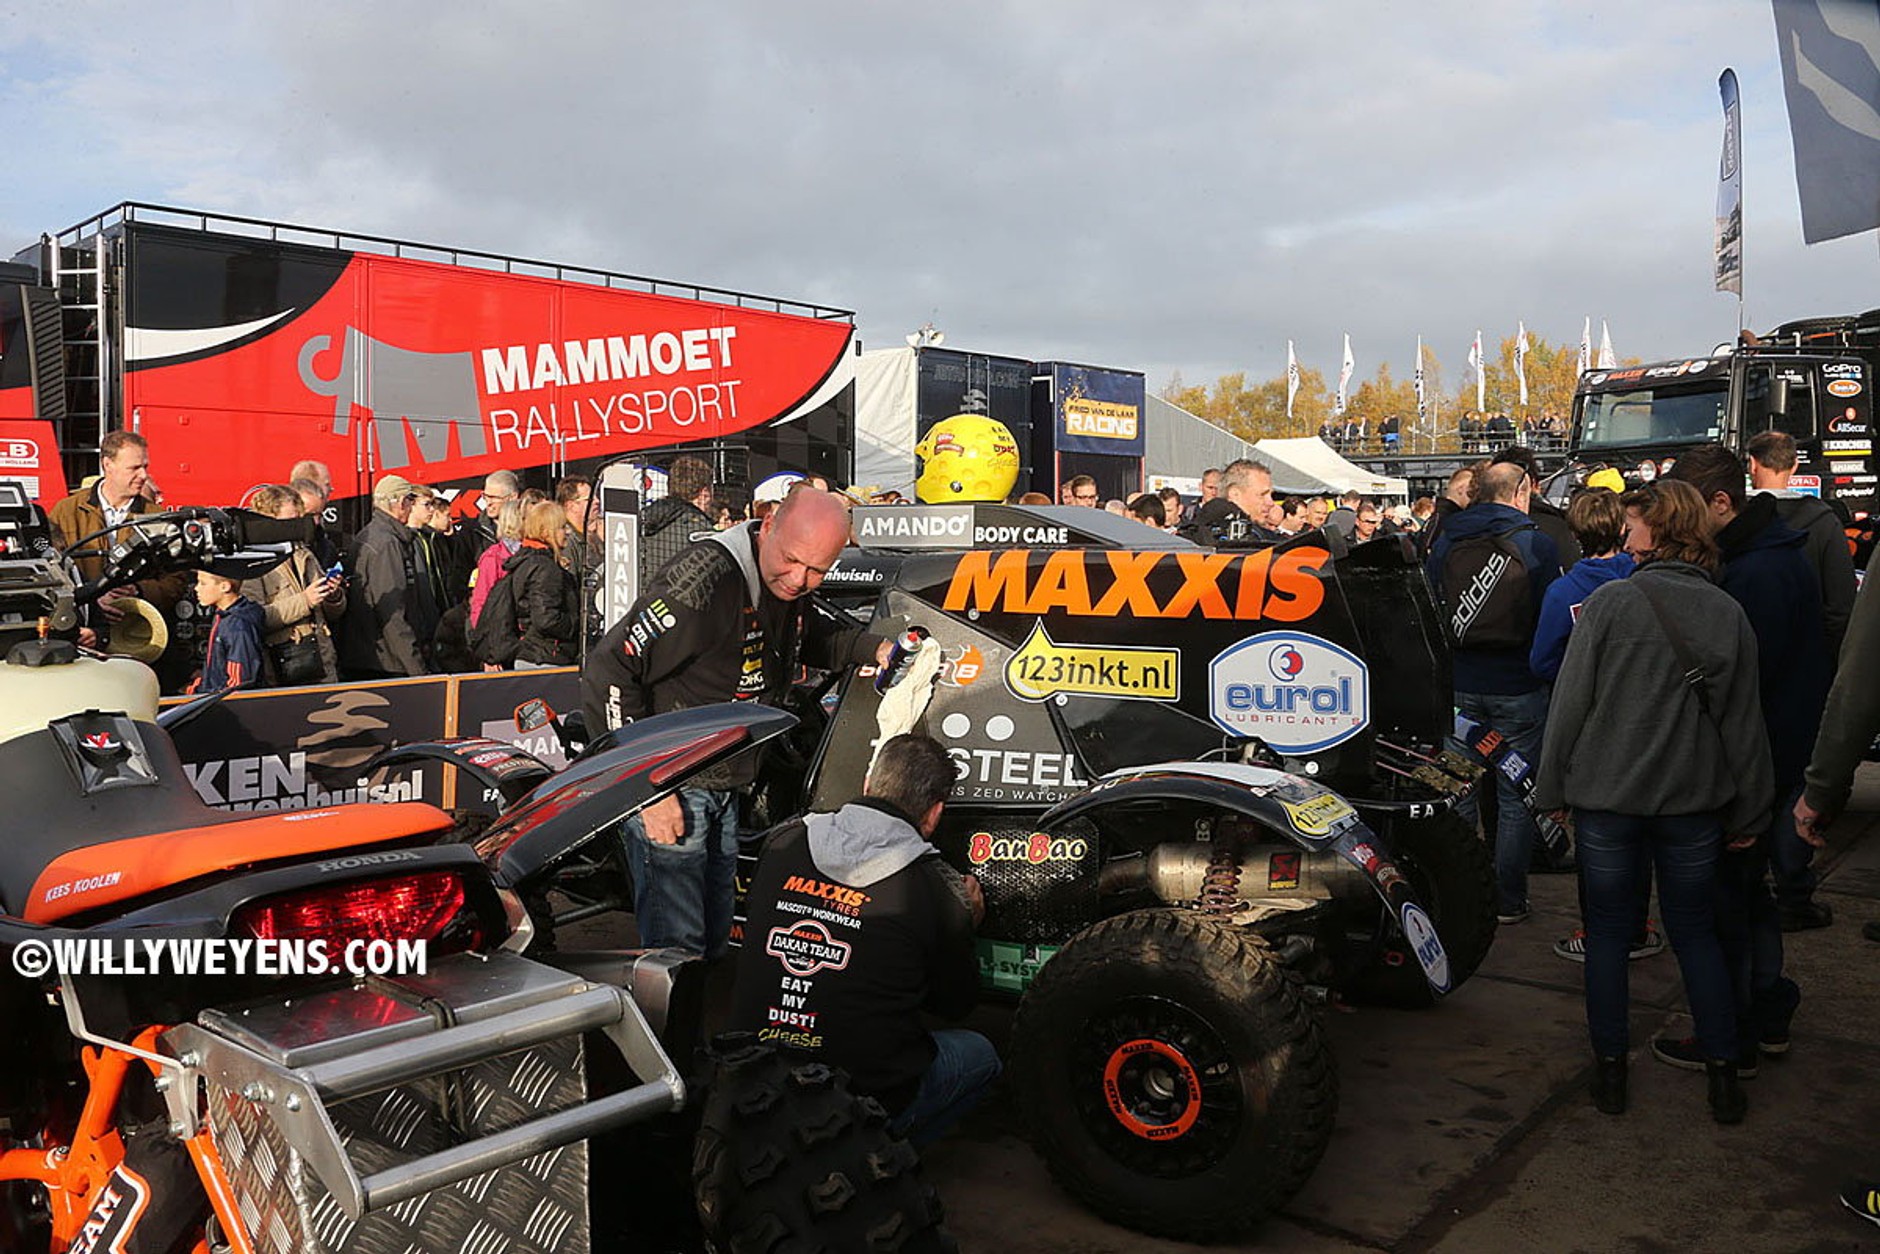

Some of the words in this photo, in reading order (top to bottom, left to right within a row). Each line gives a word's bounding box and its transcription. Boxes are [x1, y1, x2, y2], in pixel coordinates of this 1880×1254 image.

[481, 326, 736, 395] MAMMOET
[1822, 363, 1861, 373] GoPro
[490, 380, 741, 453] RALLYSPORT
[860, 514, 970, 537] AMANDO
[974, 527, 1020, 544] BODY
[1022, 528, 1069, 544] CARE
[942, 545, 1330, 622] MAXXIS
[1451, 552, 1505, 638] adidas
[1017, 656, 1171, 692] 123inkt.nl
[1226, 676, 1352, 715] eurol
[182, 751, 306, 805] KEN
[973, 787, 1004, 799] ZED
[318, 849, 423, 873] HONDA
[970, 833, 1087, 864] BanBao
[45, 881, 70, 902] KEES
[73, 872, 122, 894] KOOLEN
[782, 875, 866, 907] MAXXIS
[812, 907, 862, 929] WORKWEAR
[823, 900, 861, 917] TYRES
[773, 935, 808, 954] DAKAR
[809, 943, 842, 961] TEAM
[781, 976, 813, 994] EAT
[782, 993, 806, 1009] MY
[768, 1008, 816, 1028] DUST!
[758, 1027, 823, 1047] CHEESE
